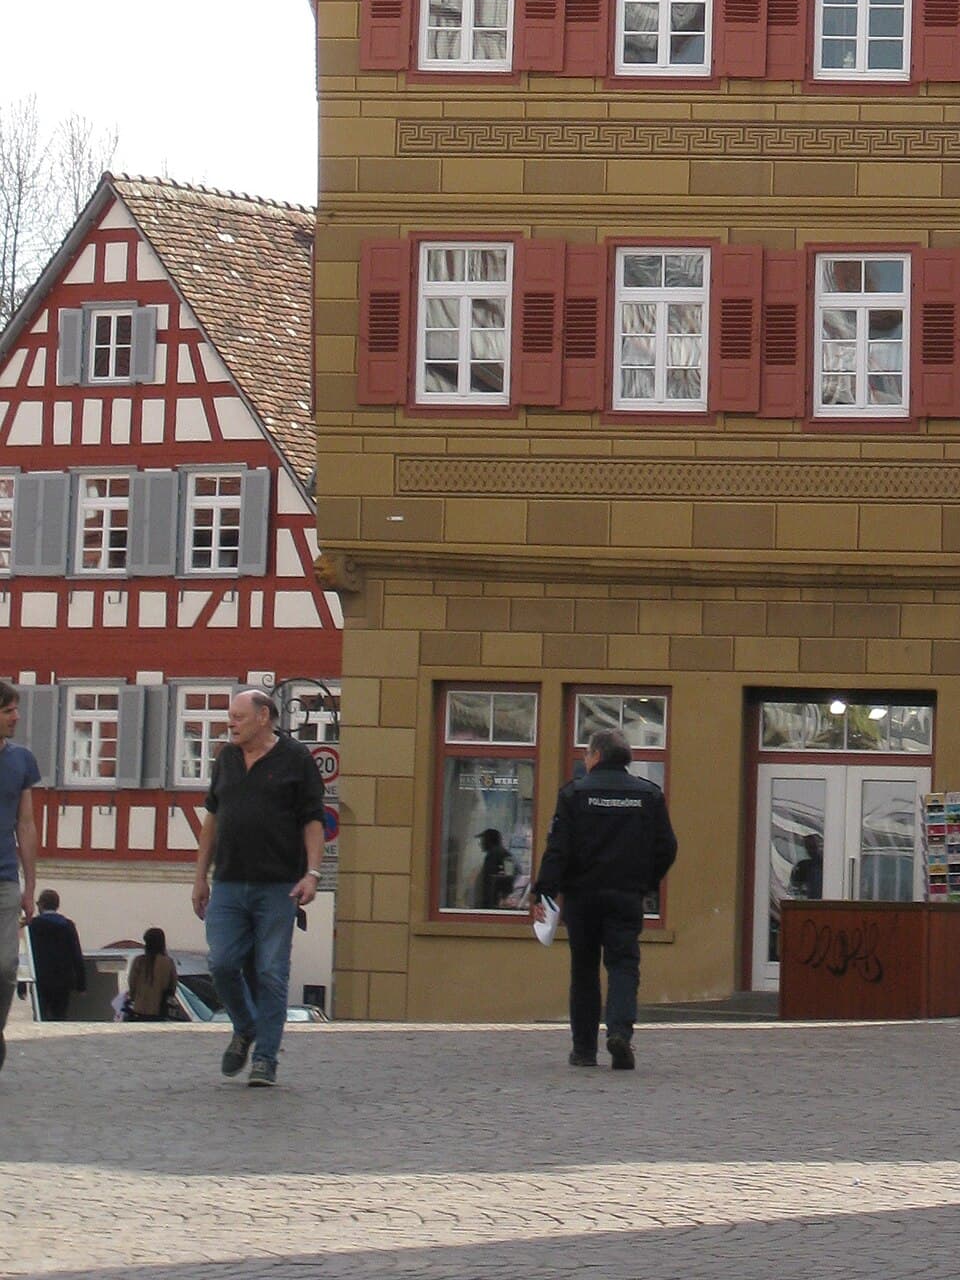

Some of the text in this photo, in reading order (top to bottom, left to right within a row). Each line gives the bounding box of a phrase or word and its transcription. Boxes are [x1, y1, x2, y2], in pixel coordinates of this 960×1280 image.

[316, 756, 335, 774] 20
[323, 786, 337, 795] NE
[324, 845, 337, 855] NE
